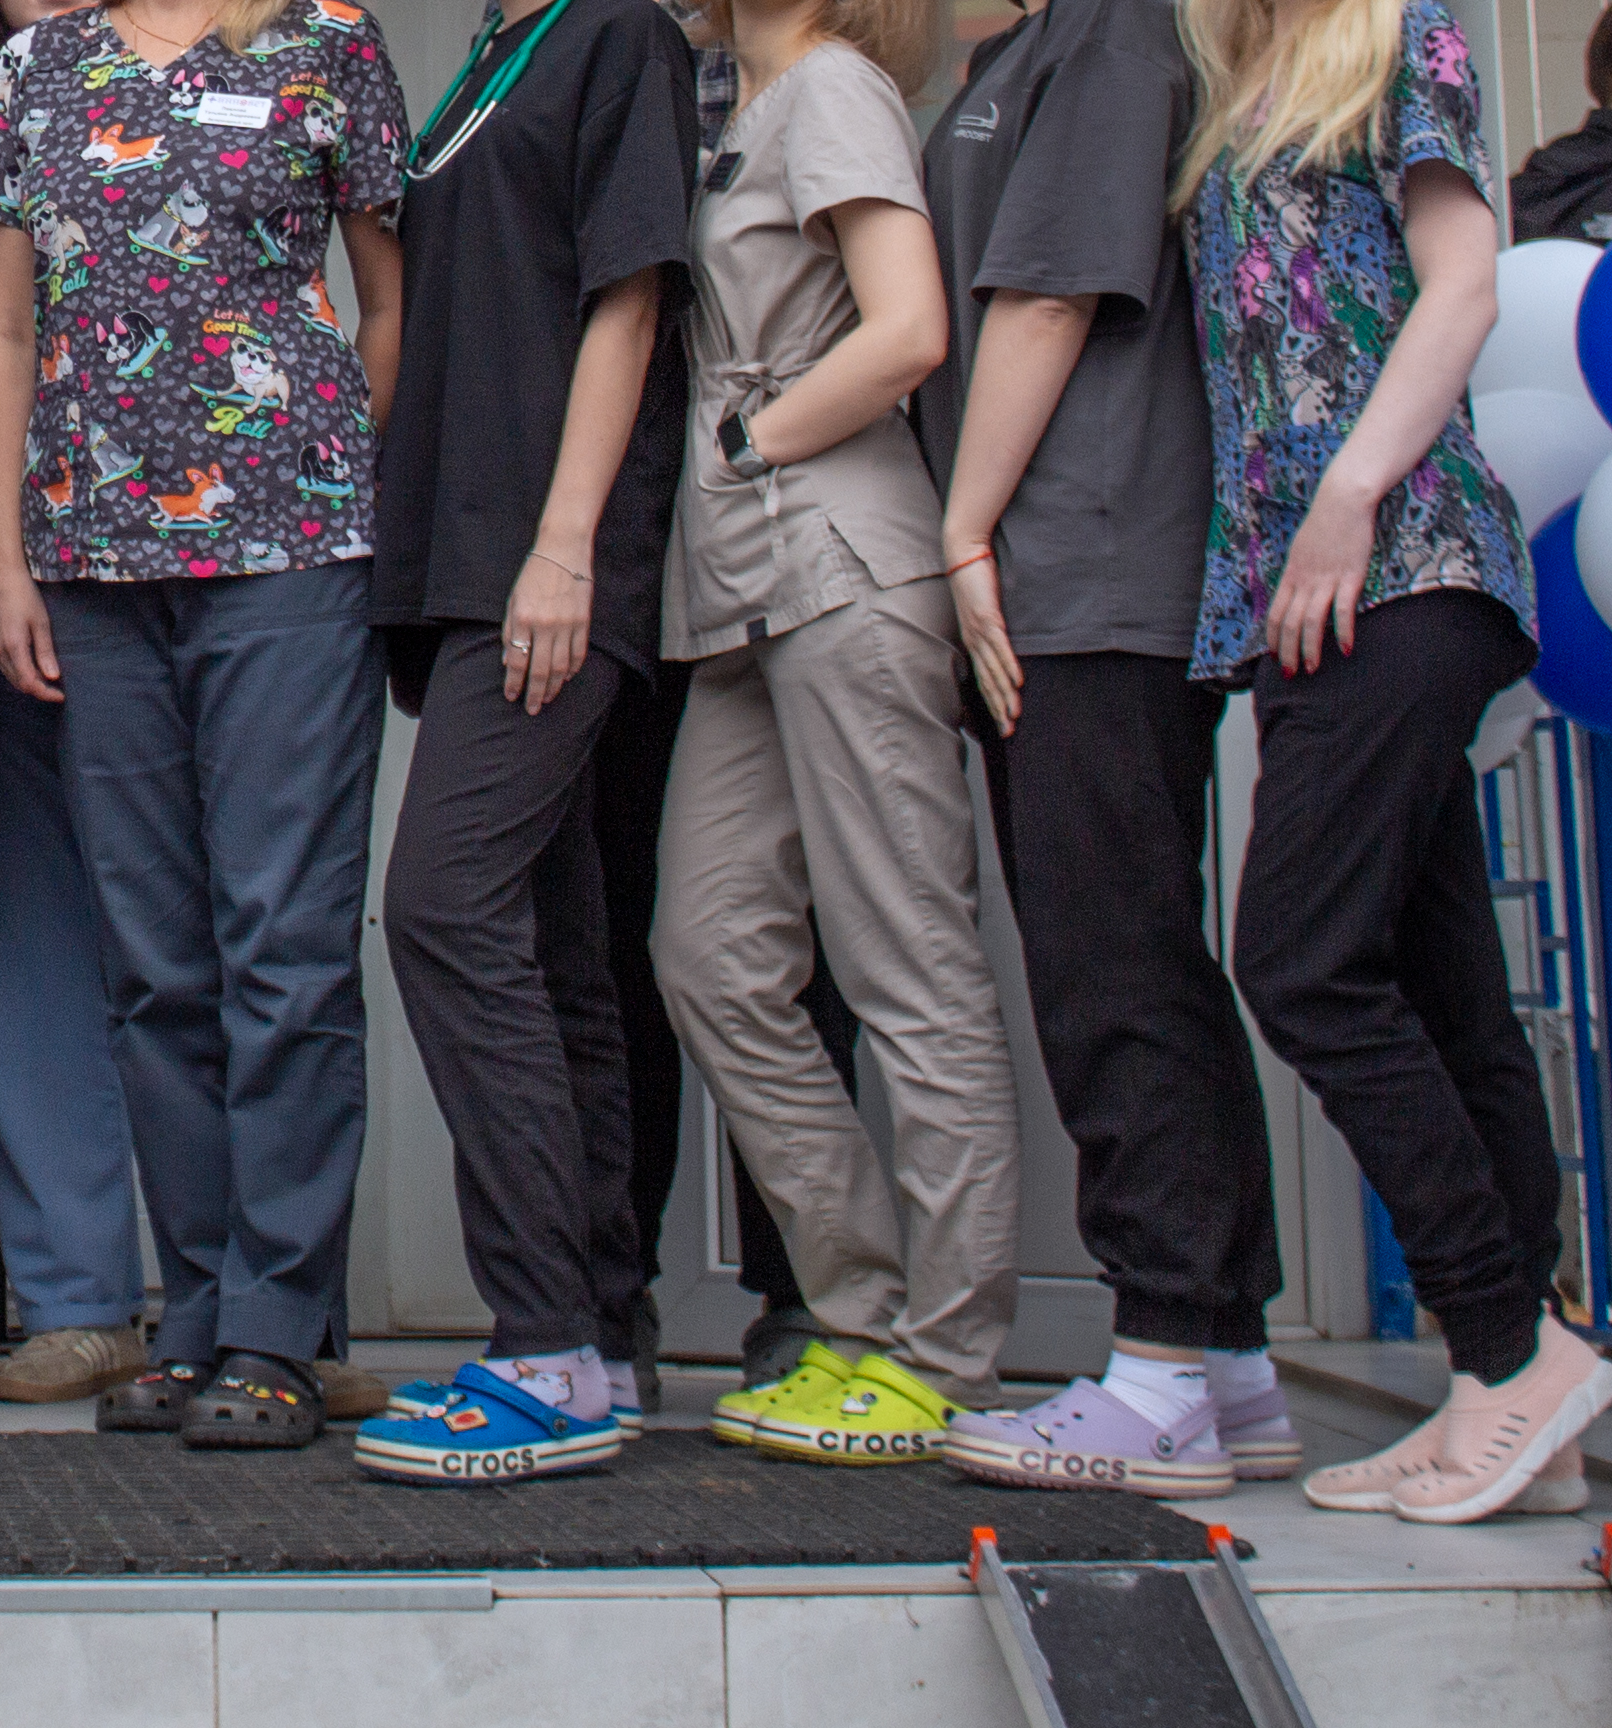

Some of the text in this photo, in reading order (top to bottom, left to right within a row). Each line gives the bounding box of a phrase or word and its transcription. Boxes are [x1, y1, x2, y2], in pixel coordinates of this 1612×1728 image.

[213, 308, 234, 320] Let
[202, 319, 272, 346] Good Times
[817, 1430, 926, 1454] crocs
[441, 1446, 535, 1477] crocs
[1017, 1450, 1127, 1481] crocs
